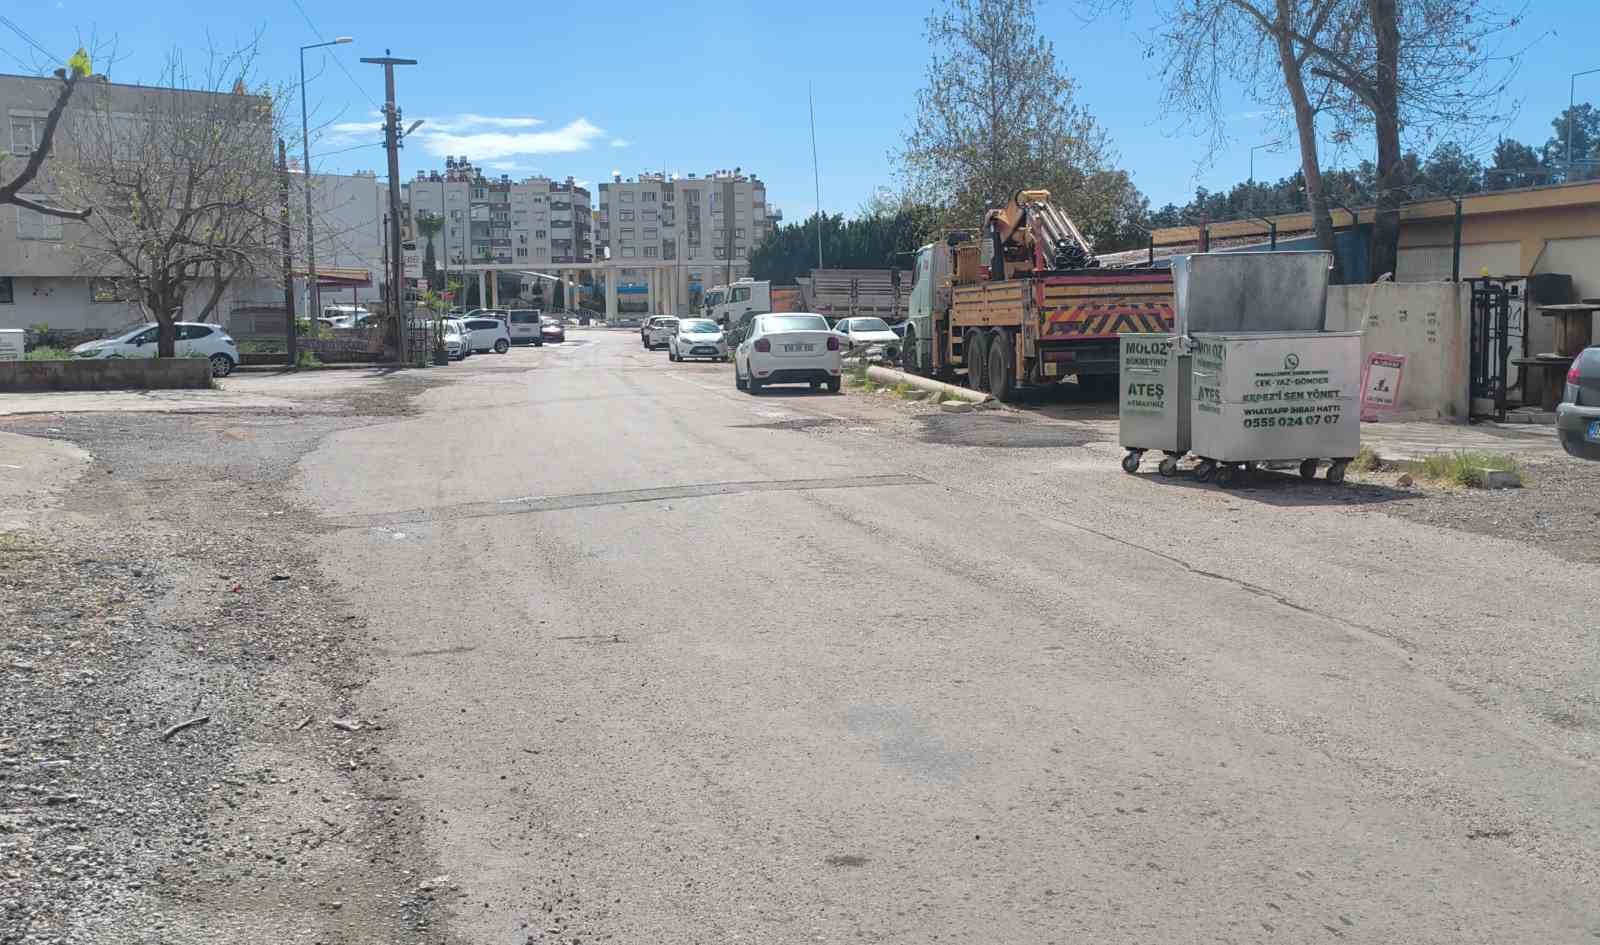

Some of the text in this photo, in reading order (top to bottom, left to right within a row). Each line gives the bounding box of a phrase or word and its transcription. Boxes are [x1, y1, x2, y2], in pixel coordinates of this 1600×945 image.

[1126, 342, 1168, 355] MOLOZ
[1128, 383, 1165, 401] ATEŞ
[1307, 388, 1341, 400] YÖNET
[1243, 414, 1340, 428] 0555 024 07 07
